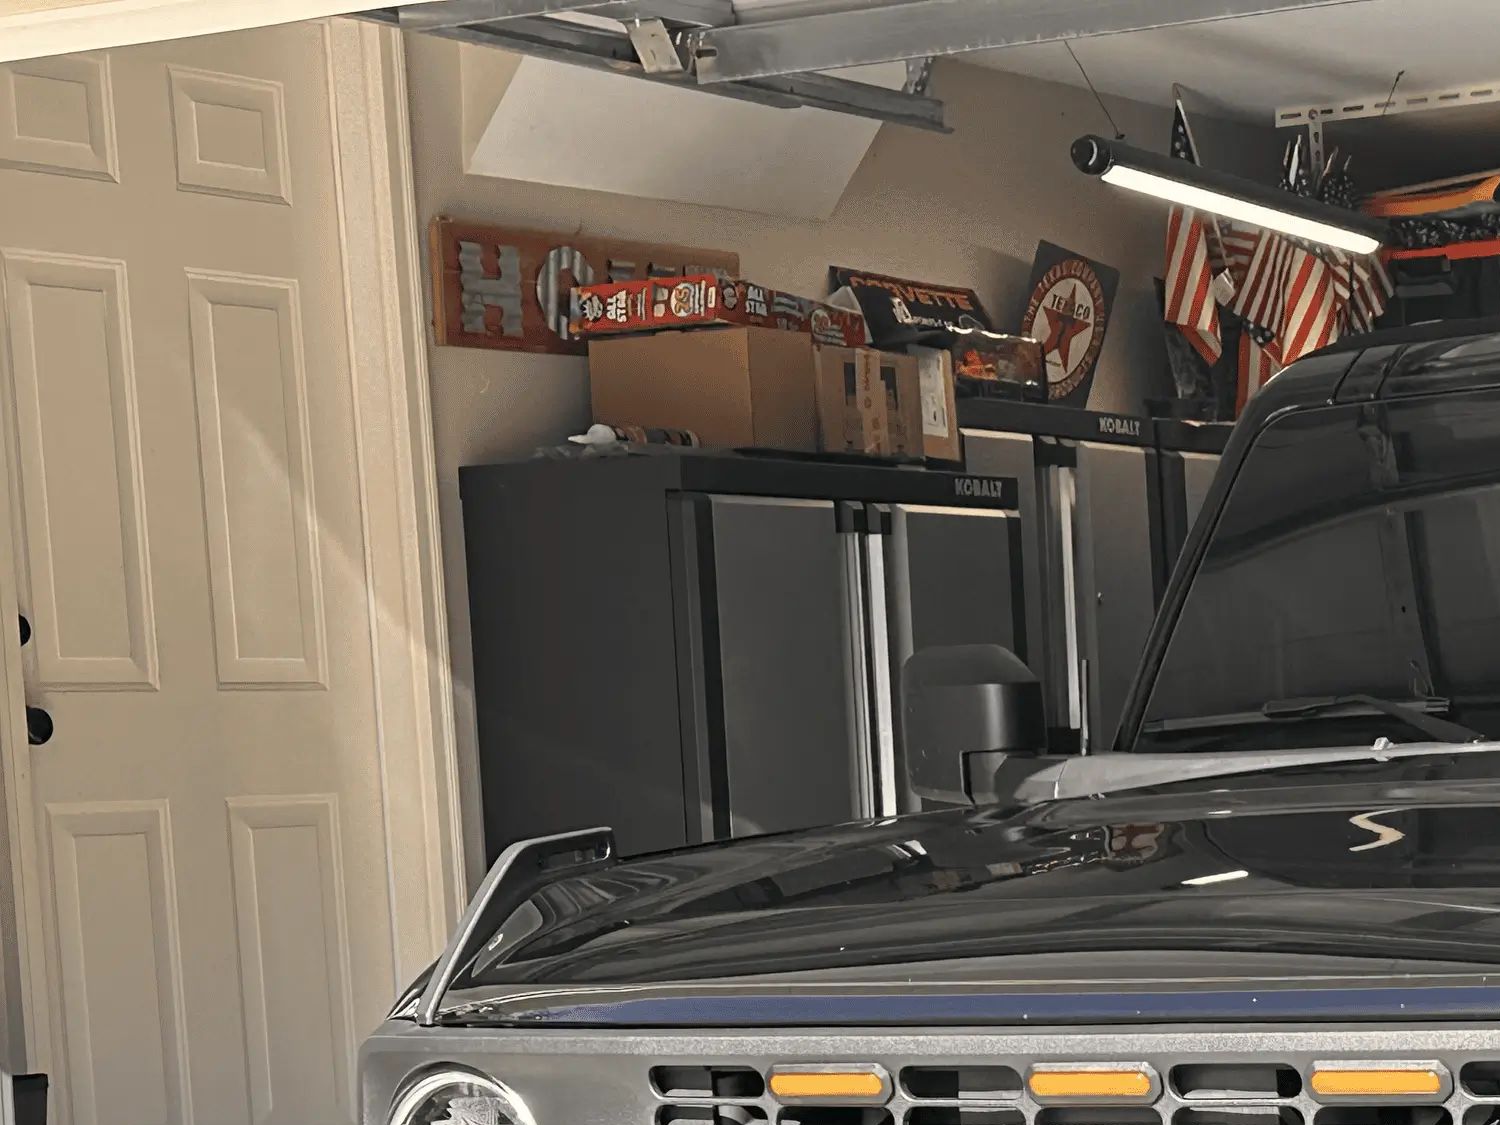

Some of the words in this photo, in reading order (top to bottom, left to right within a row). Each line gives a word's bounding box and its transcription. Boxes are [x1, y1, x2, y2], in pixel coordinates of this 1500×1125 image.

[1051, 293, 1091, 320] TECO
[1099, 416, 1141, 437] KOBALT
[954, 477, 1003, 499] KOBALT
